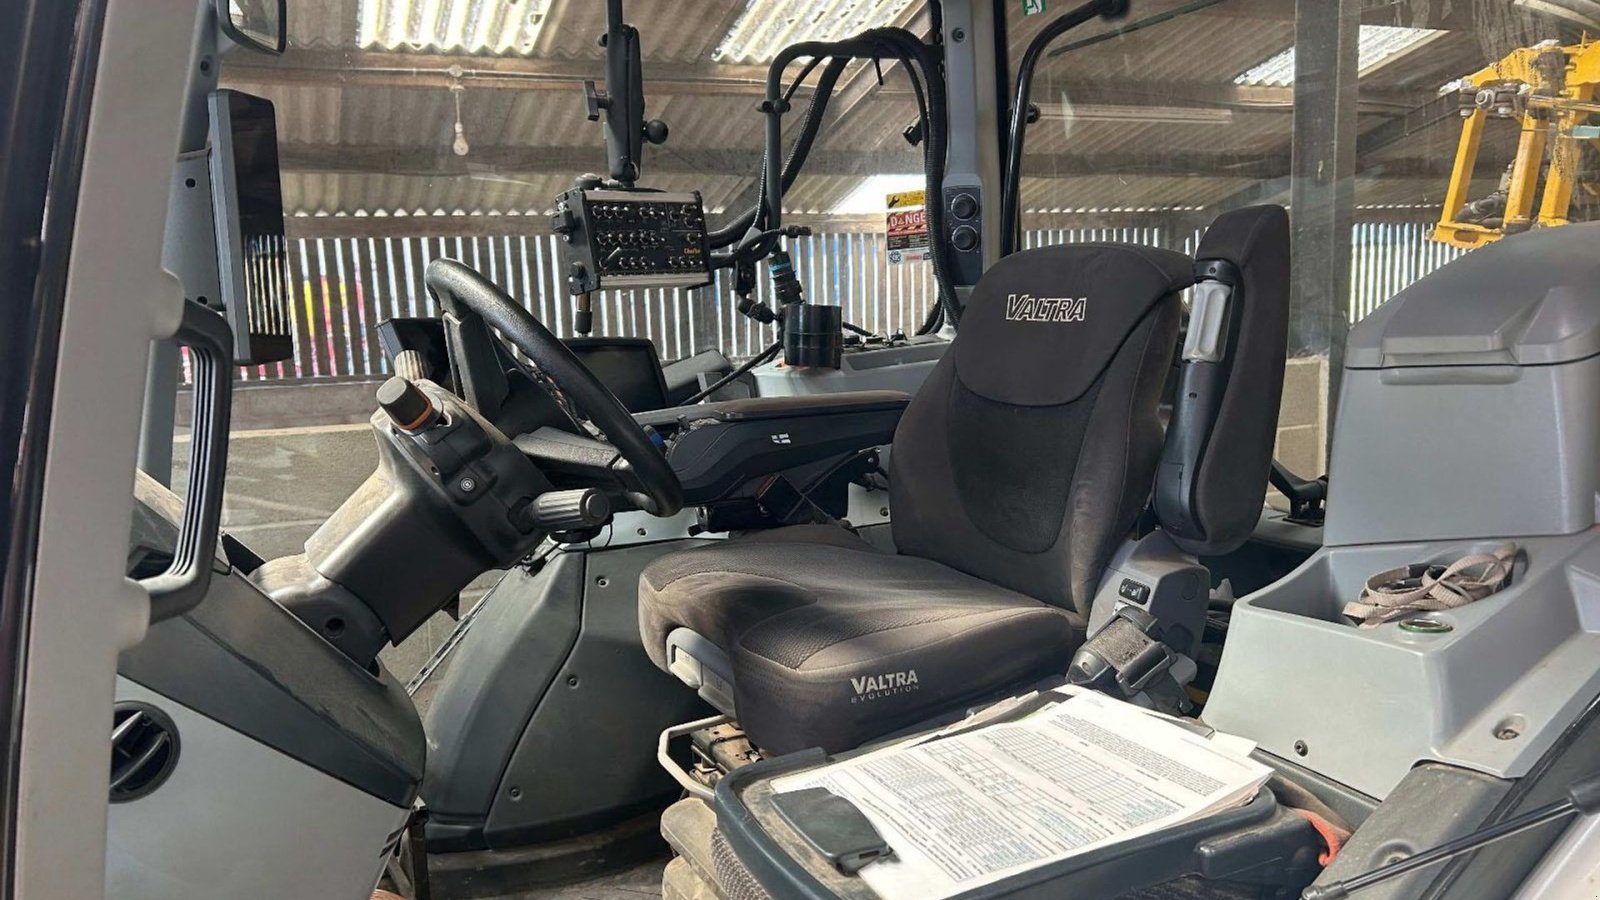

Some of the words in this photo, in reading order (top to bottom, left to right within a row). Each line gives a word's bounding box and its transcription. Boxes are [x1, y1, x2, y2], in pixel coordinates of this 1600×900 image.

[890, 212, 926, 227] DANGE
[1006, 294, 1087, 322] VALTRA
[850, 669, 918, 695] VALTRA
[850, 685, 920, 704] EVOLUTION
